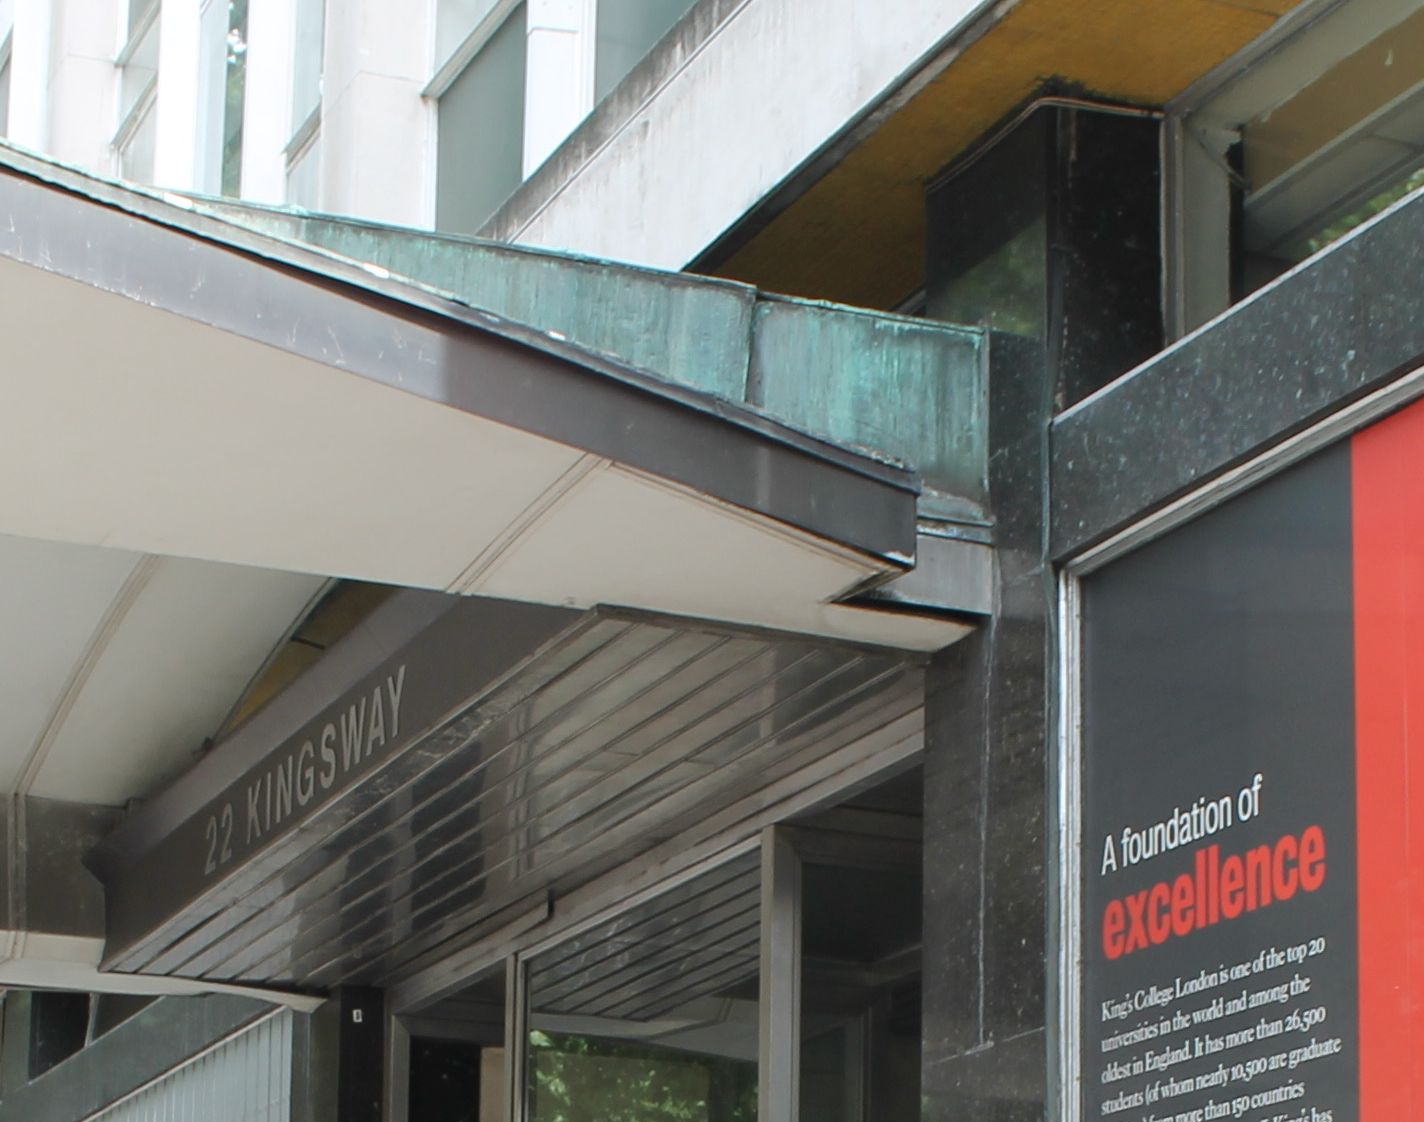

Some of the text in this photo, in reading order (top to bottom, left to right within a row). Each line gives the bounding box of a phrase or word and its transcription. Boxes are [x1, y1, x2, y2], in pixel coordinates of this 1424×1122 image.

[204, 664, 406, 876] 22 KINGSWAY
[1101, 773, 1263, 876] A foundation of
[1103, 825, 1327, 960] excellence
[1101, 937, 1325, 1022] King's College London is one of the top 20
[1101, 973, 1311, 1052] universities in the world and among the
[1101, 1006, 1326, 1084] oldest in England. It has more than 26,500
[1101, 1037, 1342, 1115] students (of whom nearly 10,500 are graduate
[1204, 1099, 1231, 1121] than
[1231, 1095, 1250, 1118] 150
[1250, 1078, 1305, 1109] countries
